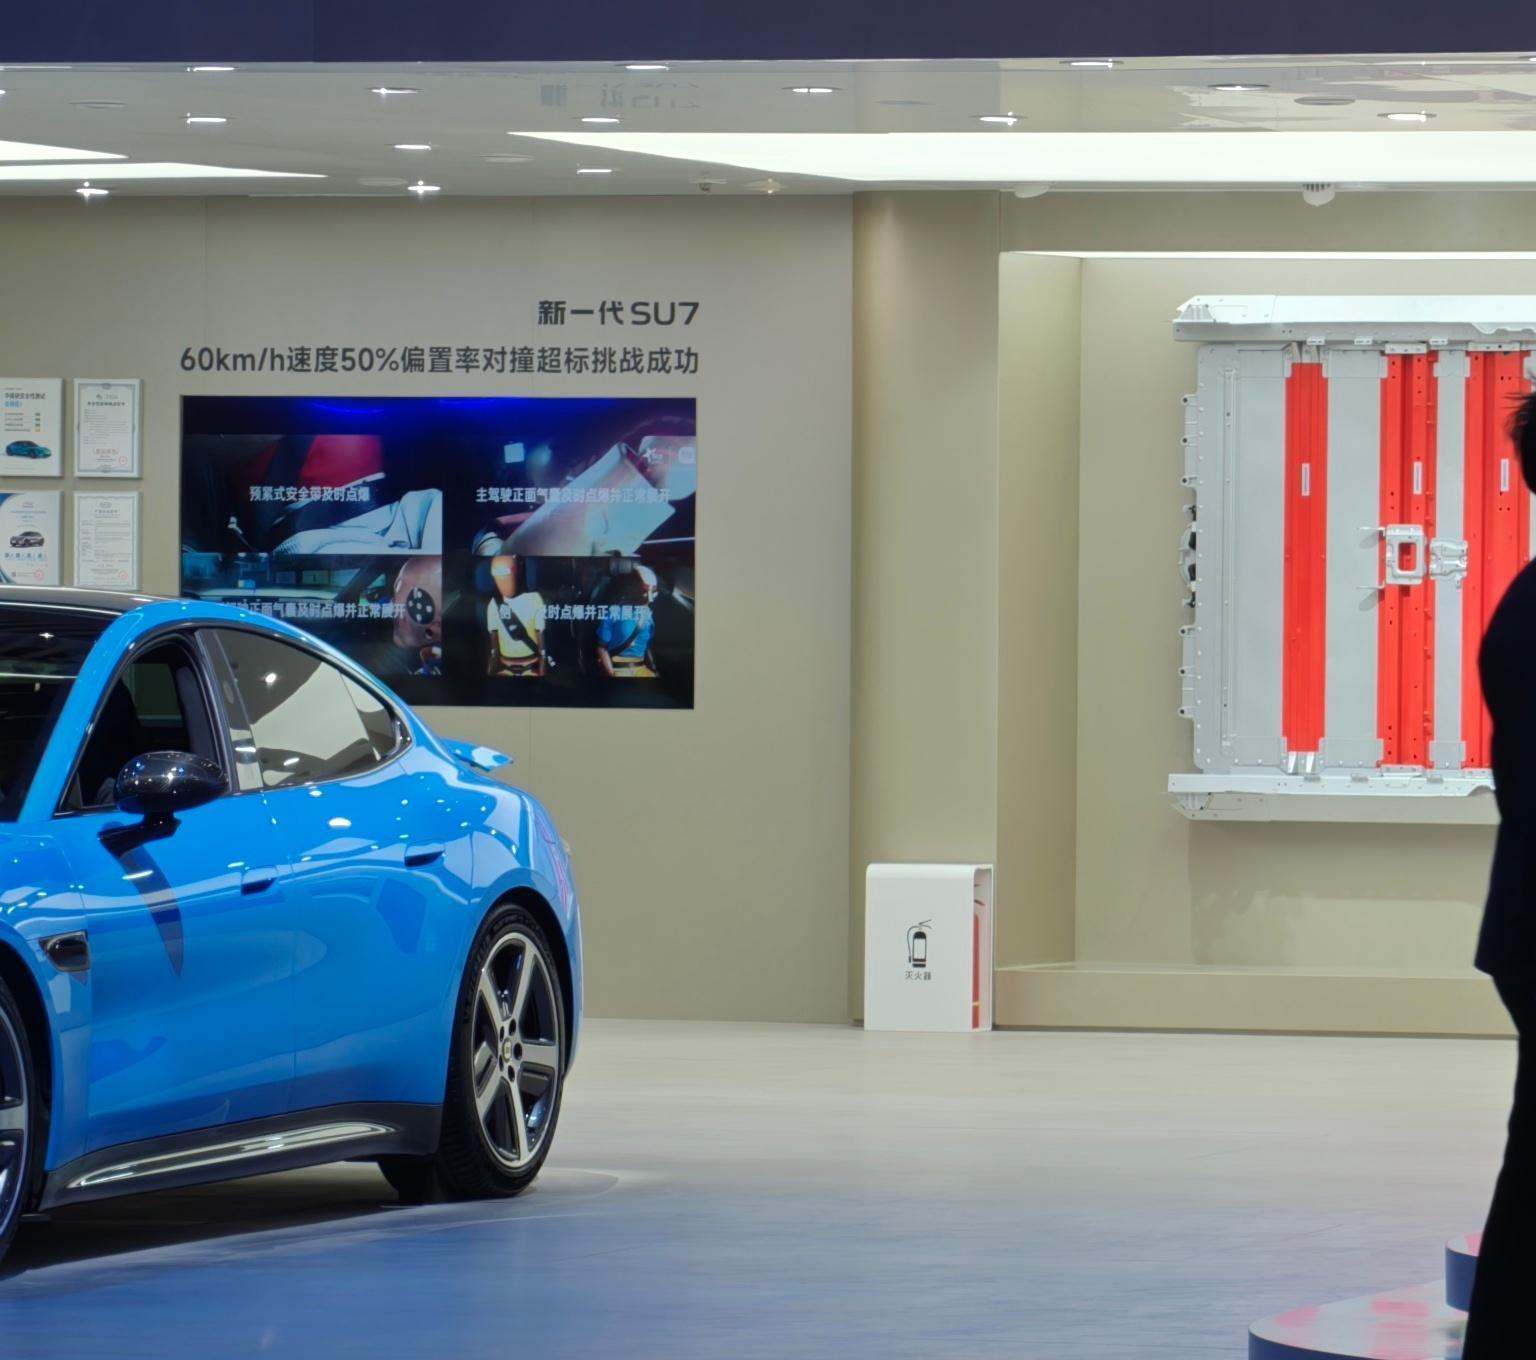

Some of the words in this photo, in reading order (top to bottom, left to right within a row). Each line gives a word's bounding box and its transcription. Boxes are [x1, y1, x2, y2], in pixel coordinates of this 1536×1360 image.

[180, 345, 699, 375] 60km/h速度50%偏置率对撞超标挑战成功
[904, 971, 932, 981] 灭火器
